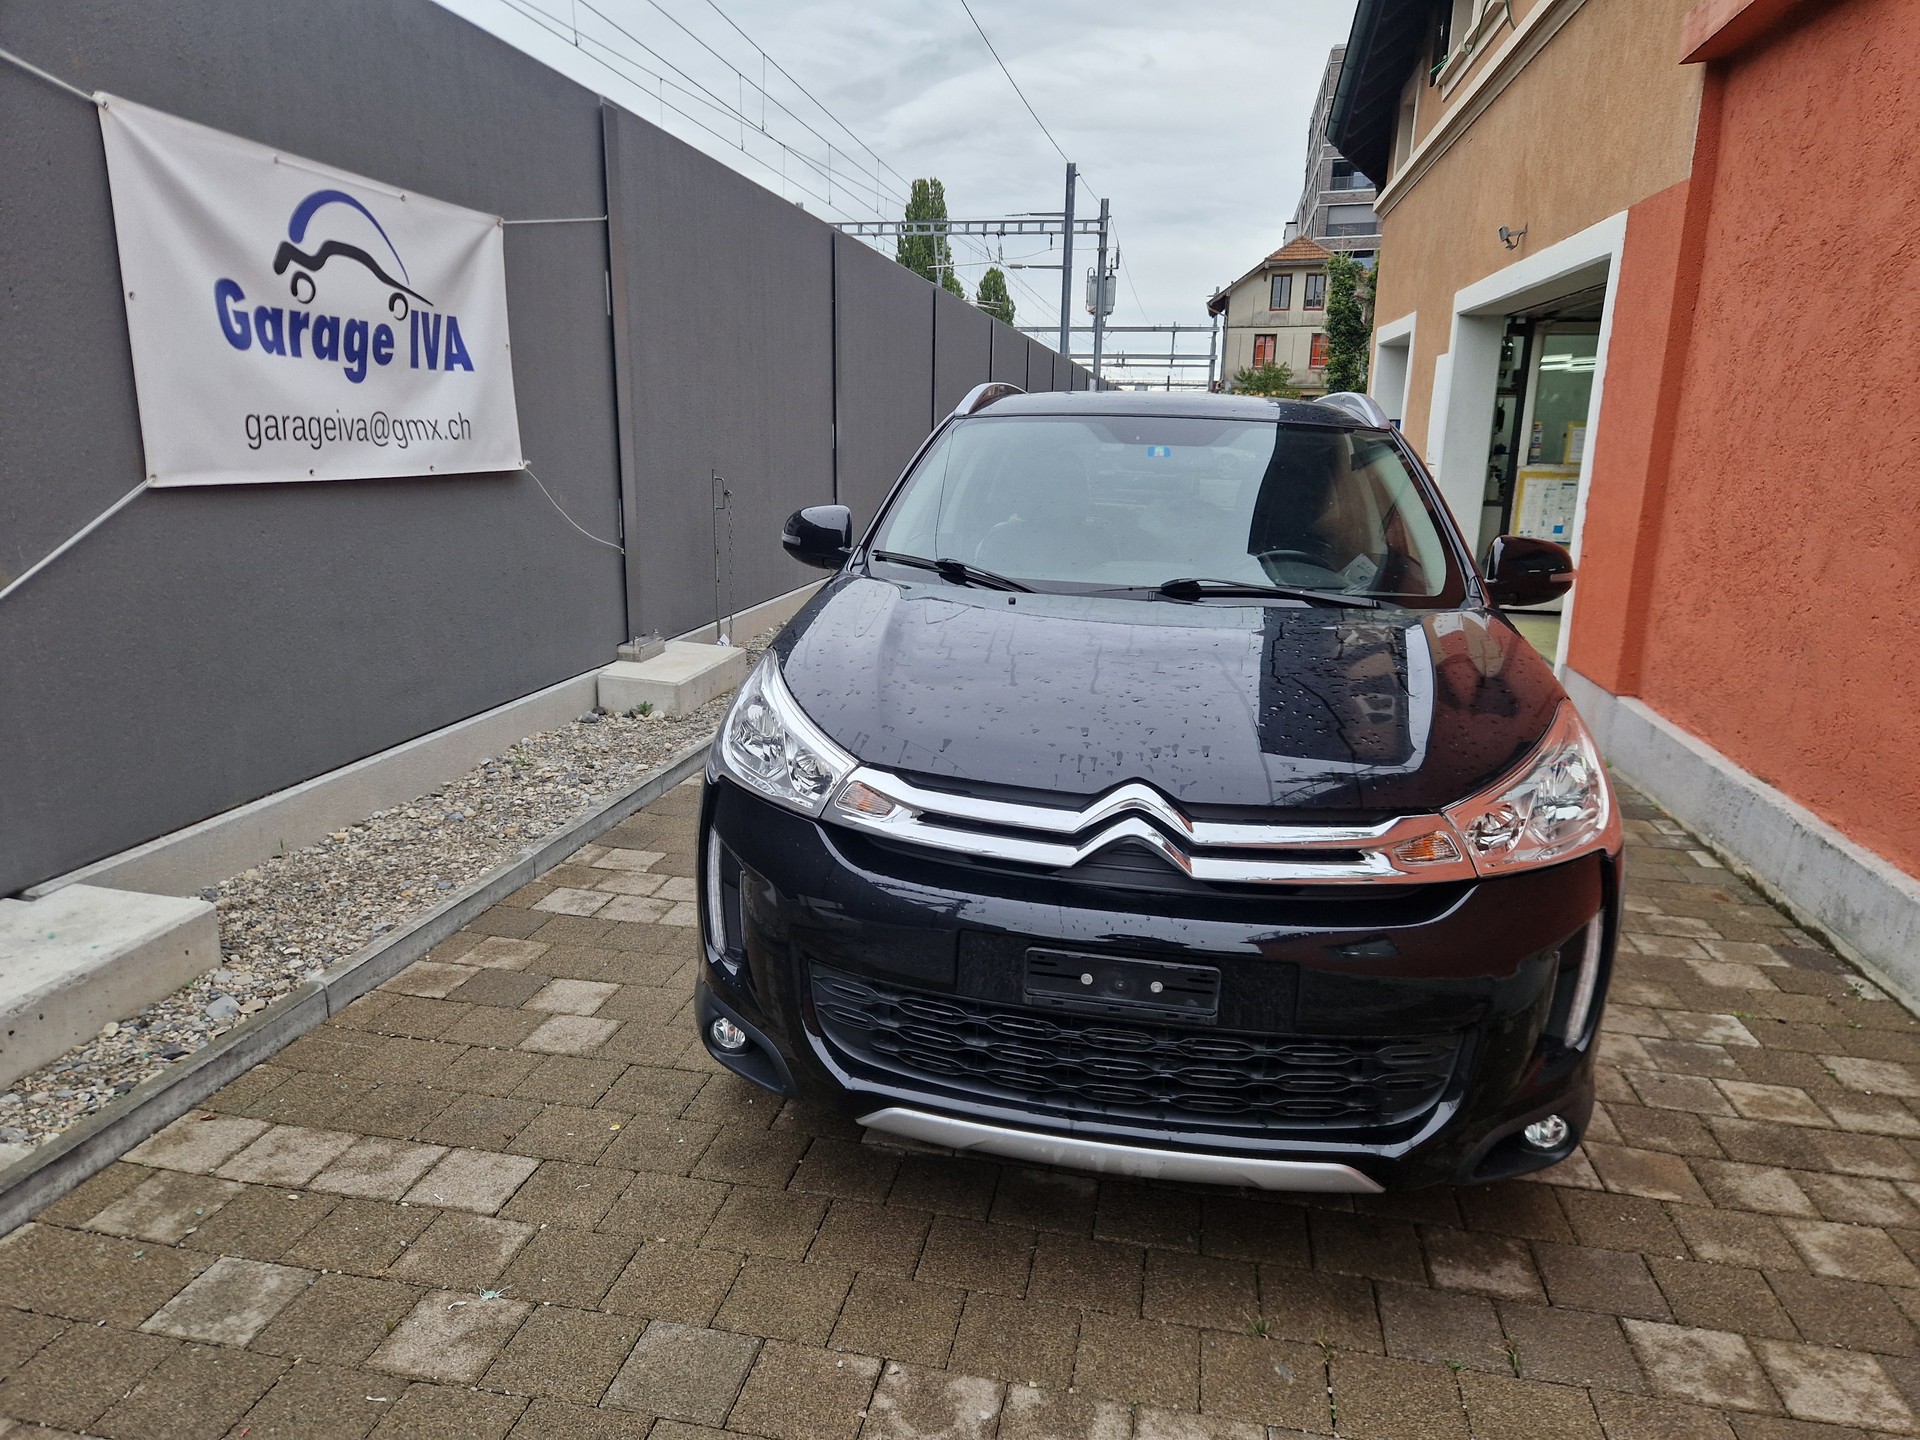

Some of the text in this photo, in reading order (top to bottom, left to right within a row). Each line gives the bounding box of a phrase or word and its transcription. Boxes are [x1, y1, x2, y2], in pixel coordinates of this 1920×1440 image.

[214, 277, 475, 383] Garage IVA
[245, 409, 472, 450] garageiva@gmx.ch
